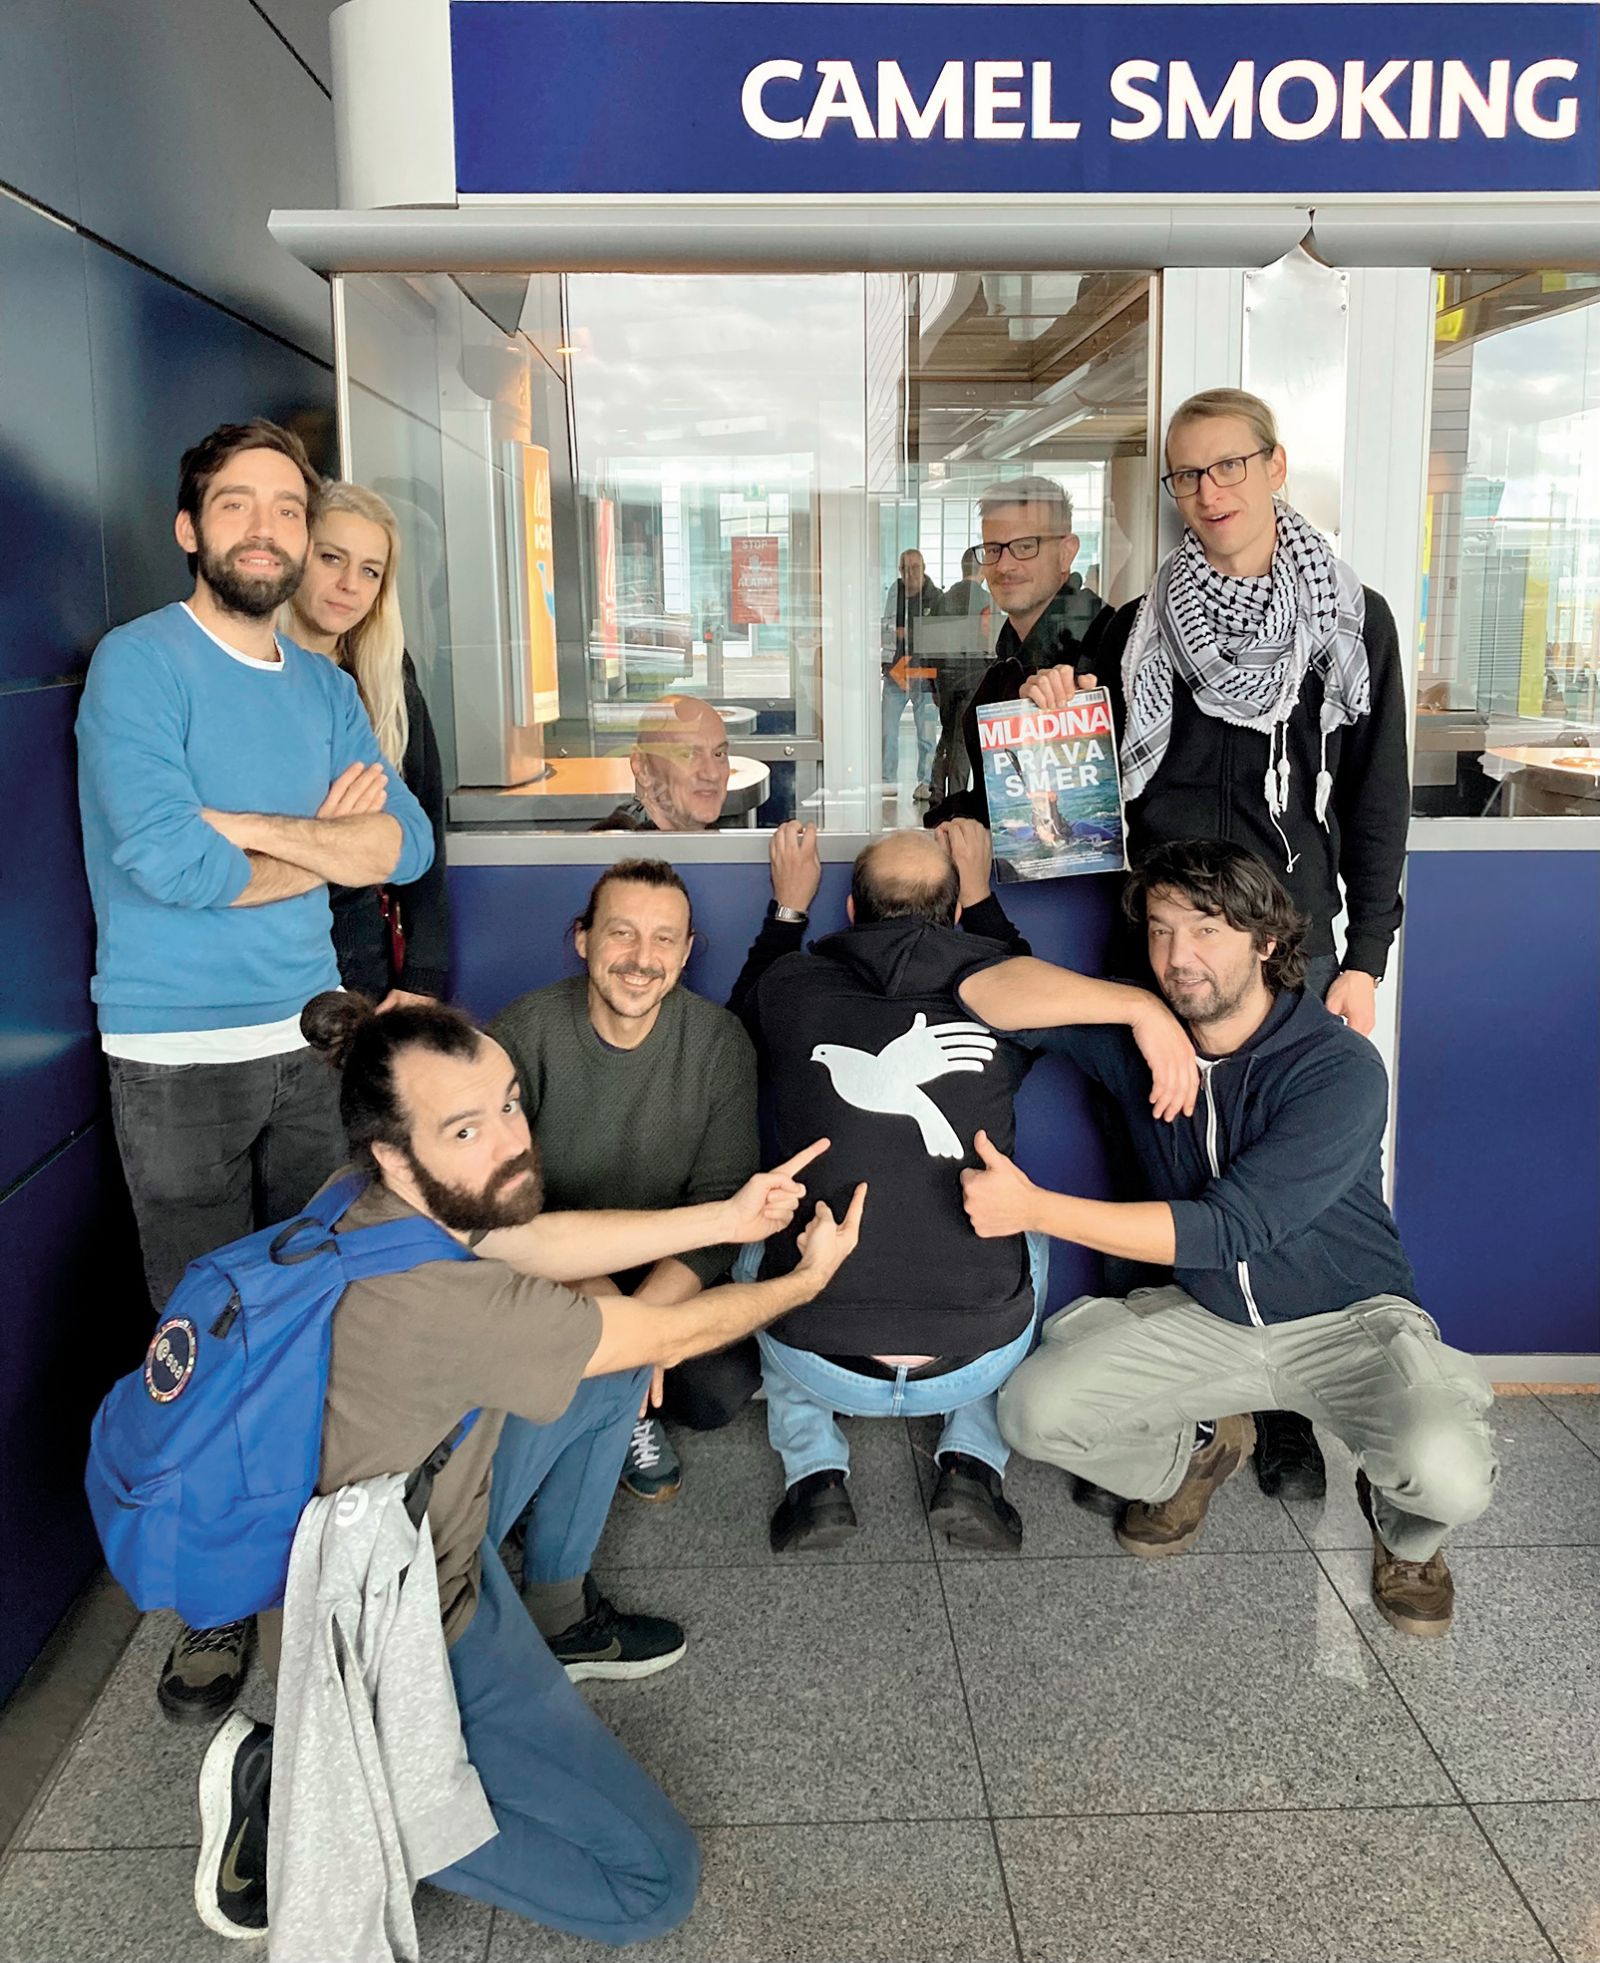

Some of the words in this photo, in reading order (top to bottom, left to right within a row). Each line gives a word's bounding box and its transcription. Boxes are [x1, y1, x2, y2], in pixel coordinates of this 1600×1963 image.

[741, 59, 1081, 140] CAMEL
[1110, 59, 1579, 141] SMOKING
[742, 539, 768, 550] STOP
[737, 576, 773, 588] ALARM
[978, 706, 1111, 748] MLADINA
[993, 739, 1105, 775] PRAVA
[1005, 764, 1100, 798] SMER
